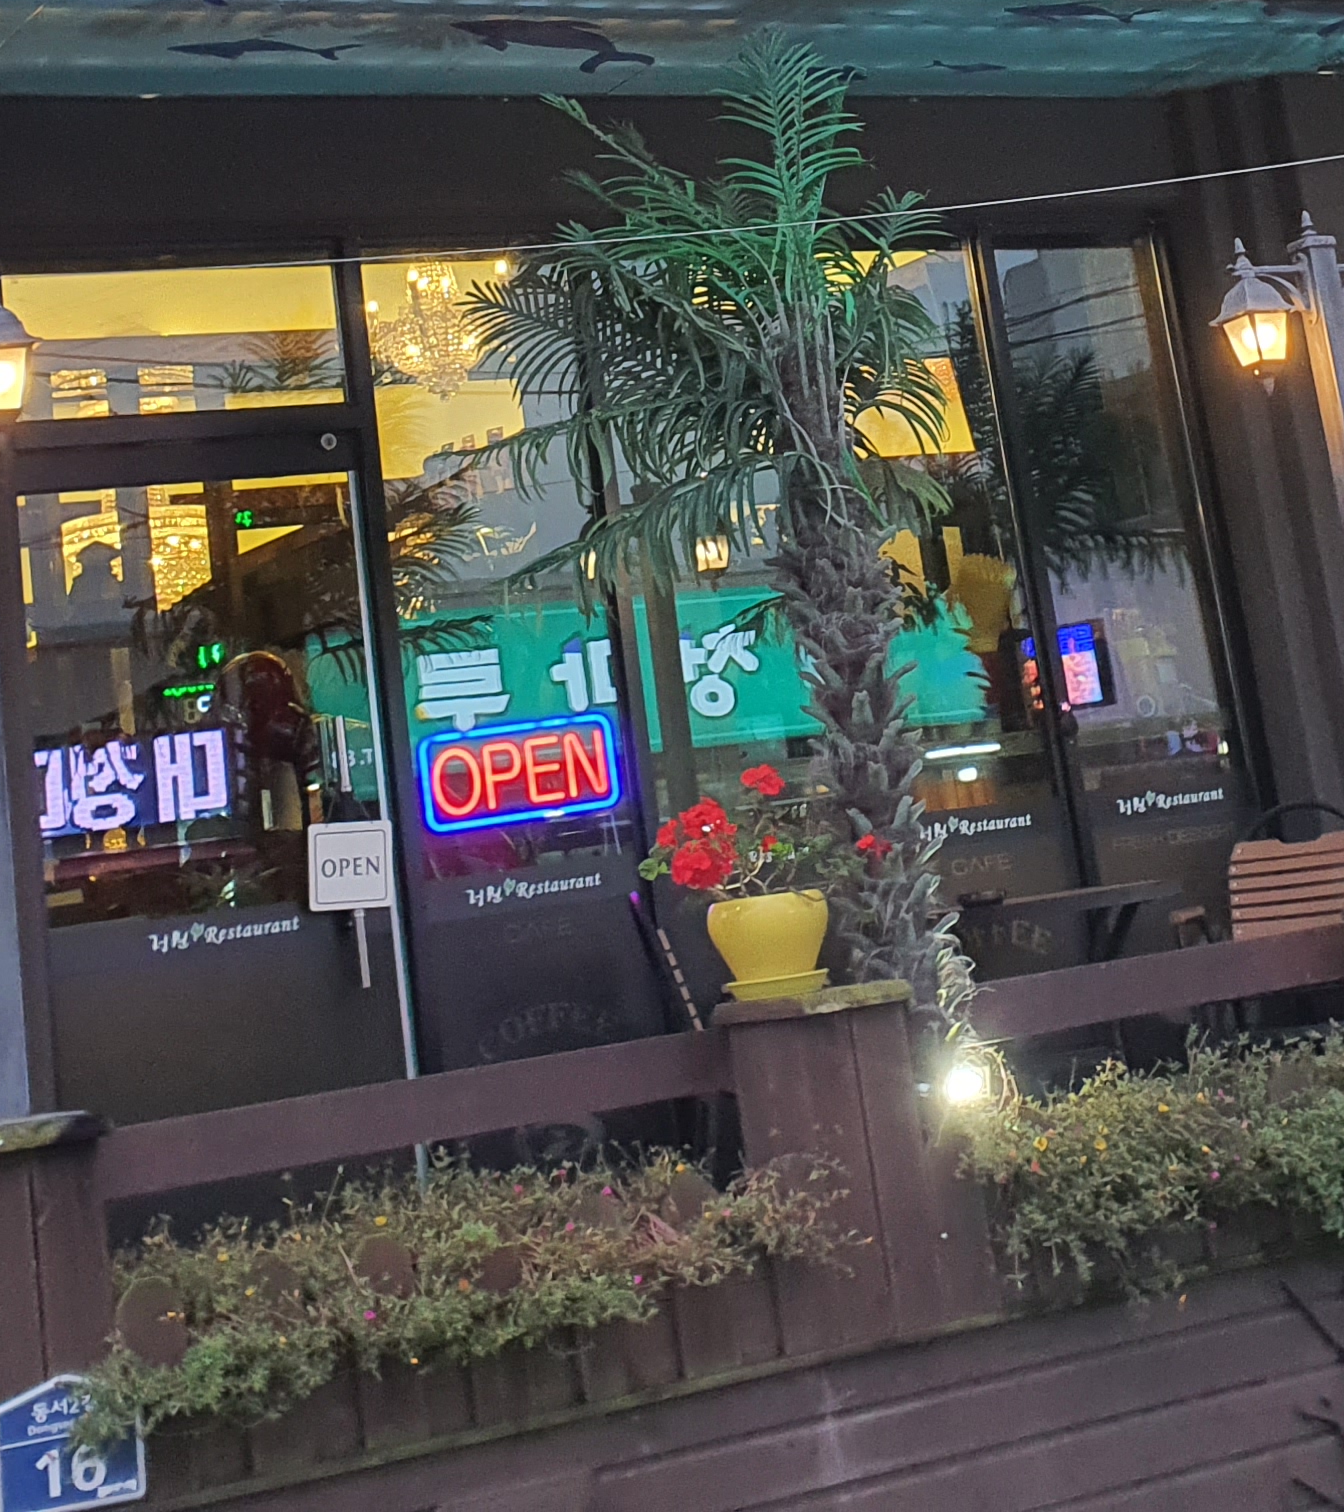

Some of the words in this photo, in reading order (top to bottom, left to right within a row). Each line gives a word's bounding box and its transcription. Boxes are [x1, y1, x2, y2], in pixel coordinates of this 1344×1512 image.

[431, 729, 610, 817] OPEN
[1156, 787, 1224, 810] Restaurant
[959, 813, 1032, 836] Restaurant
[321, 855, 380, 878] OPEN
[516, 872, 602, 899] Restaurant
[204, 915, 301, 945] Restaurant
[35, 1444, 107, 1498] 16
